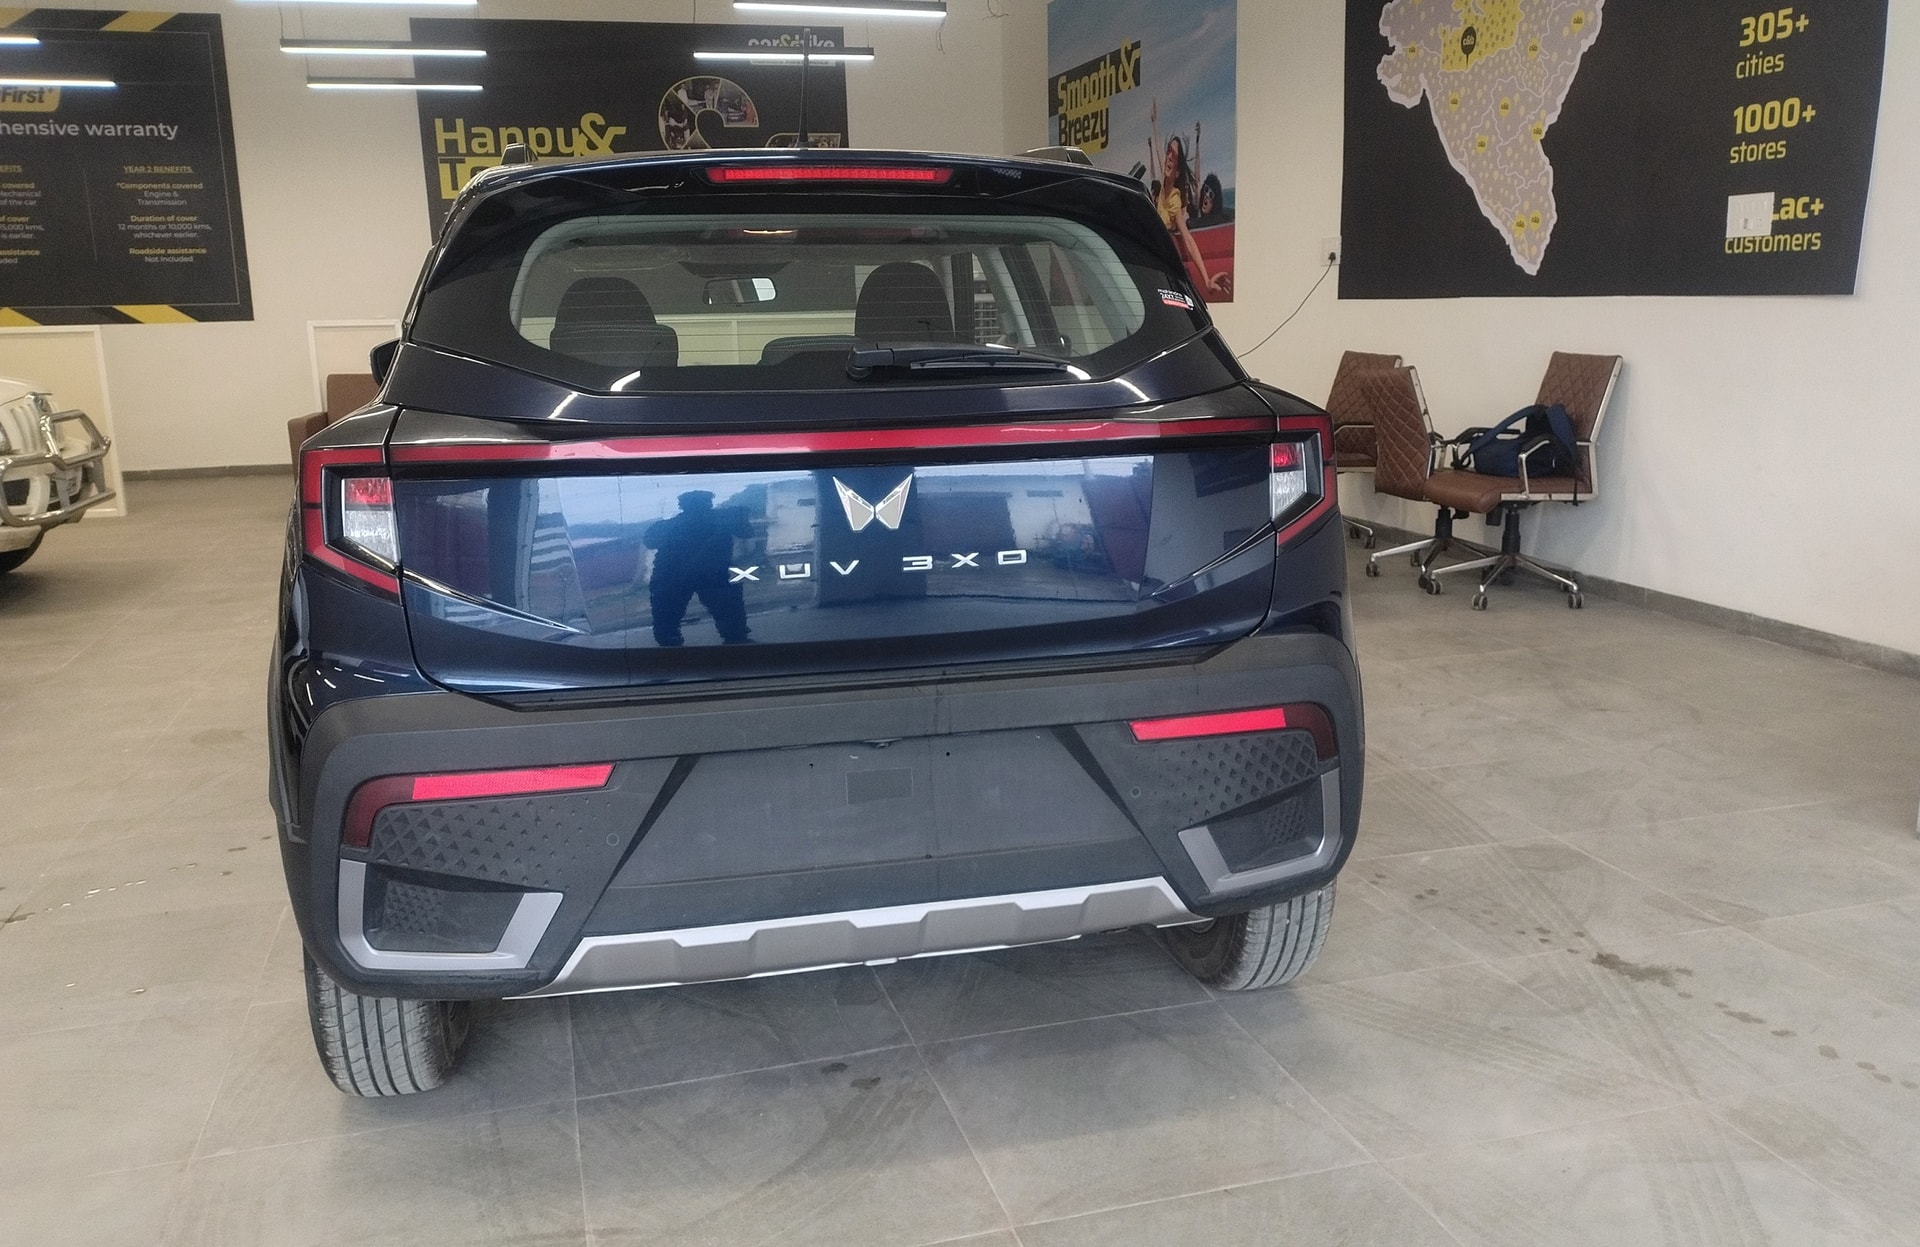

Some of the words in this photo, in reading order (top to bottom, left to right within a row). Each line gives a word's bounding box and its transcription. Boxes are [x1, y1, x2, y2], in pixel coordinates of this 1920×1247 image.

[1739, 8, 1809, 47] 305+
[1736, 51, 1785, 79] cities
[1733, 97, 1816, 135] 1000+
[84, 122, 178, 140] warranty
[1058, 107, 1109, 150] Breezy
[1729, 141, 1787, 164] stores
[153, 166, 194, 174] BENEFITS
[129, 247, 165, 255] Roadside
[1724, 232, 1821, 254] customers
[728, 559, 860, 583] XUV
